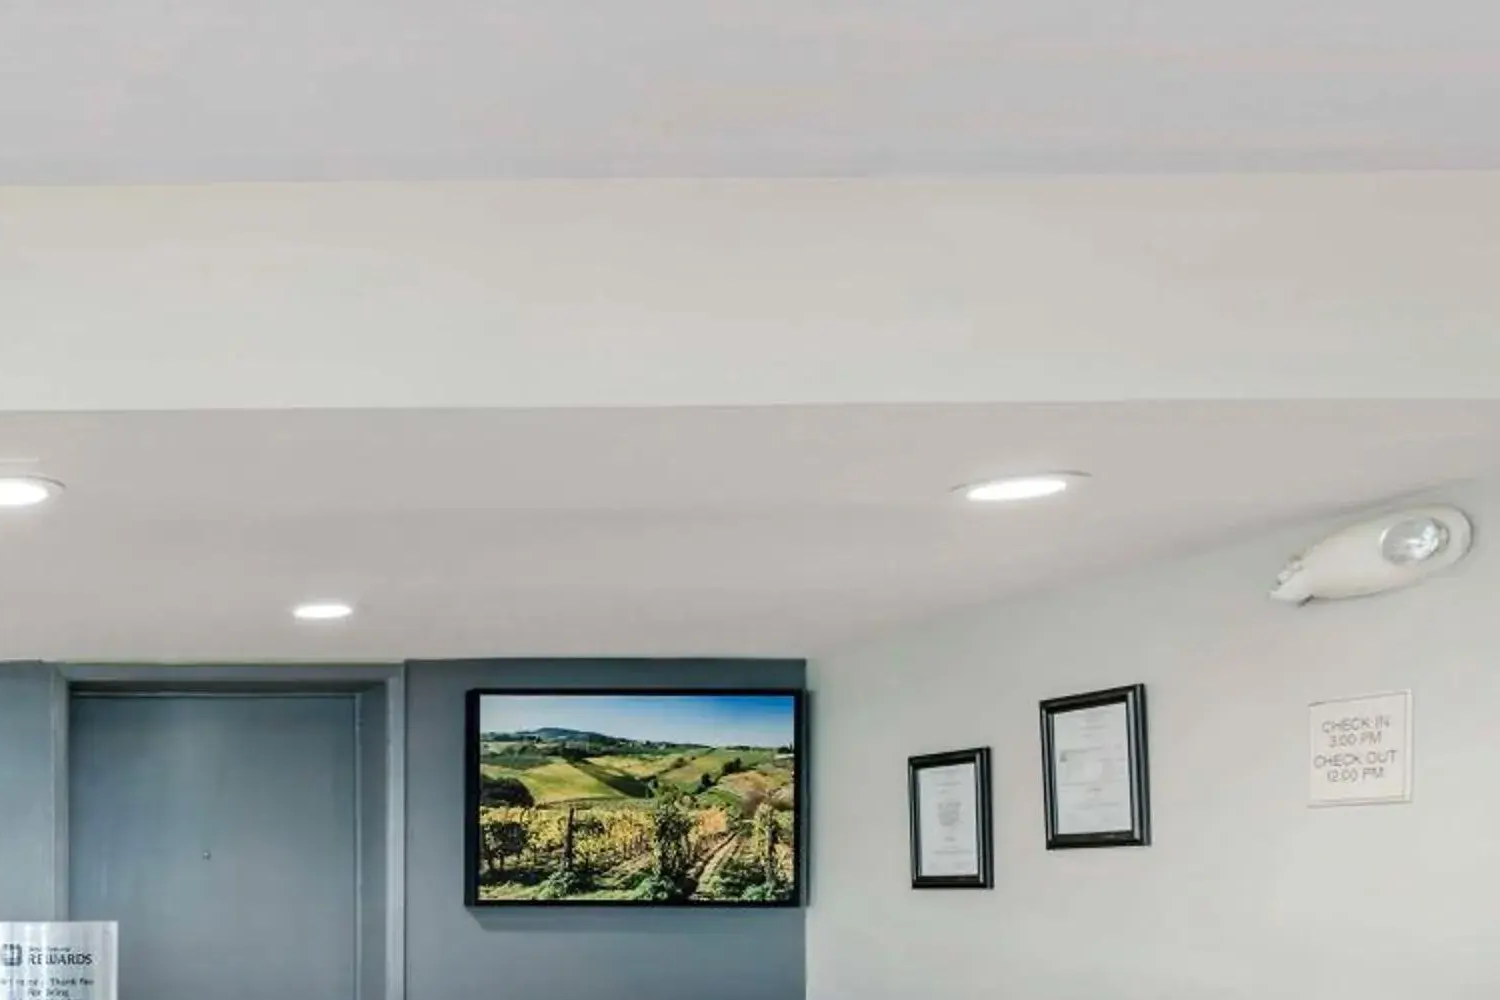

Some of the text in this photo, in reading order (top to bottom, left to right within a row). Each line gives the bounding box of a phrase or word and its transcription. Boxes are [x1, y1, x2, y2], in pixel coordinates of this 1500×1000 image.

[1322, 717, 1370, 733] CHECK
[1360, 730, 1382, 744] PM
[1313, 749, 1398, 769] CHECK OUT
[1362, 766, 1384, 780] PM
[28, 953, 93, 965] REWARDS
